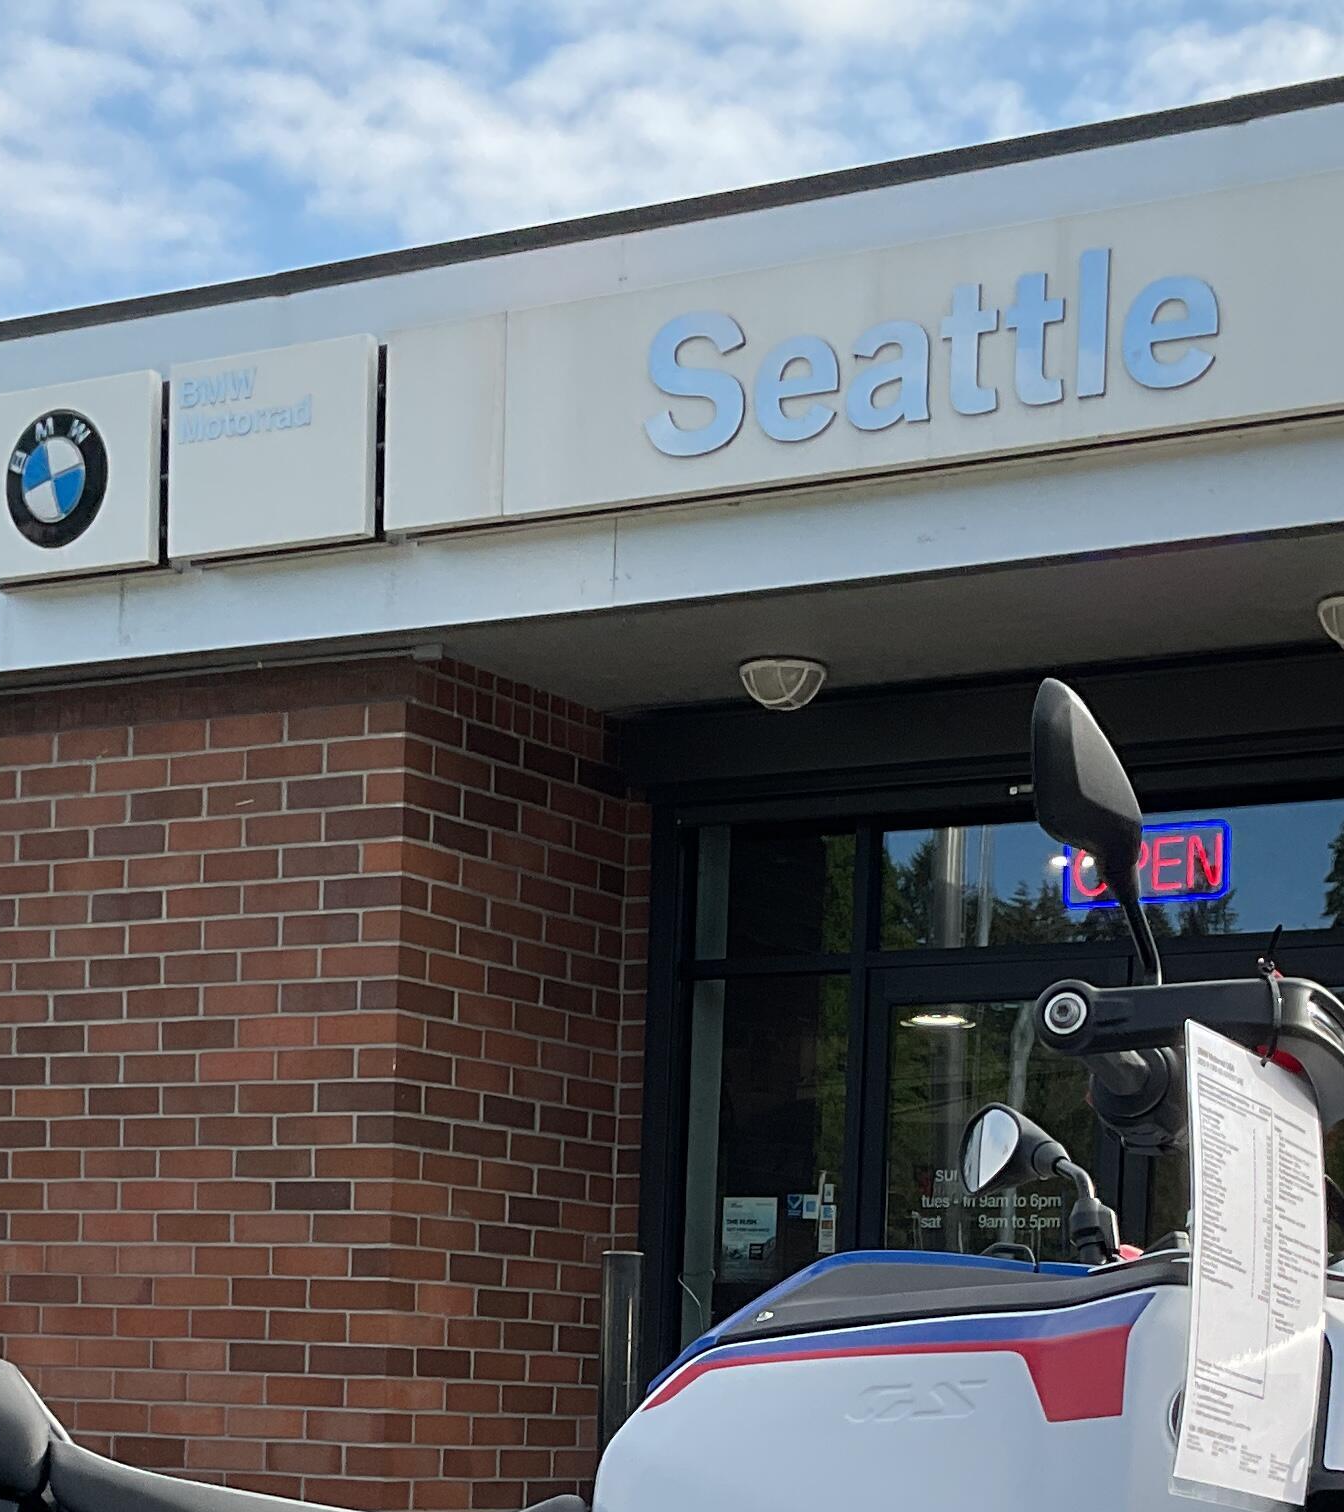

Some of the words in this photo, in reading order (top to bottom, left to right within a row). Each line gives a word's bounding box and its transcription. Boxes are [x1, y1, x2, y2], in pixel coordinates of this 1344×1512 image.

[643, 247, 1220, 458] Seattle
[180, 366, 257, 409] BMW
[179, 394, 312, 445] Motorrad
[921, 1195, 950, 1208] tues
[979, 1194, 1007, 1207] 9am
[1014, 1196, 1027, 1207] to
[1030, 1194, 1061, 1210] 6pm
[921, 1215, 941, 1229] sat
[978, 1215, 1006, 1228] 9am
[1012, 1216, 1027, 1228] to
[1030, 1215, 1060, 1230] 5pm
